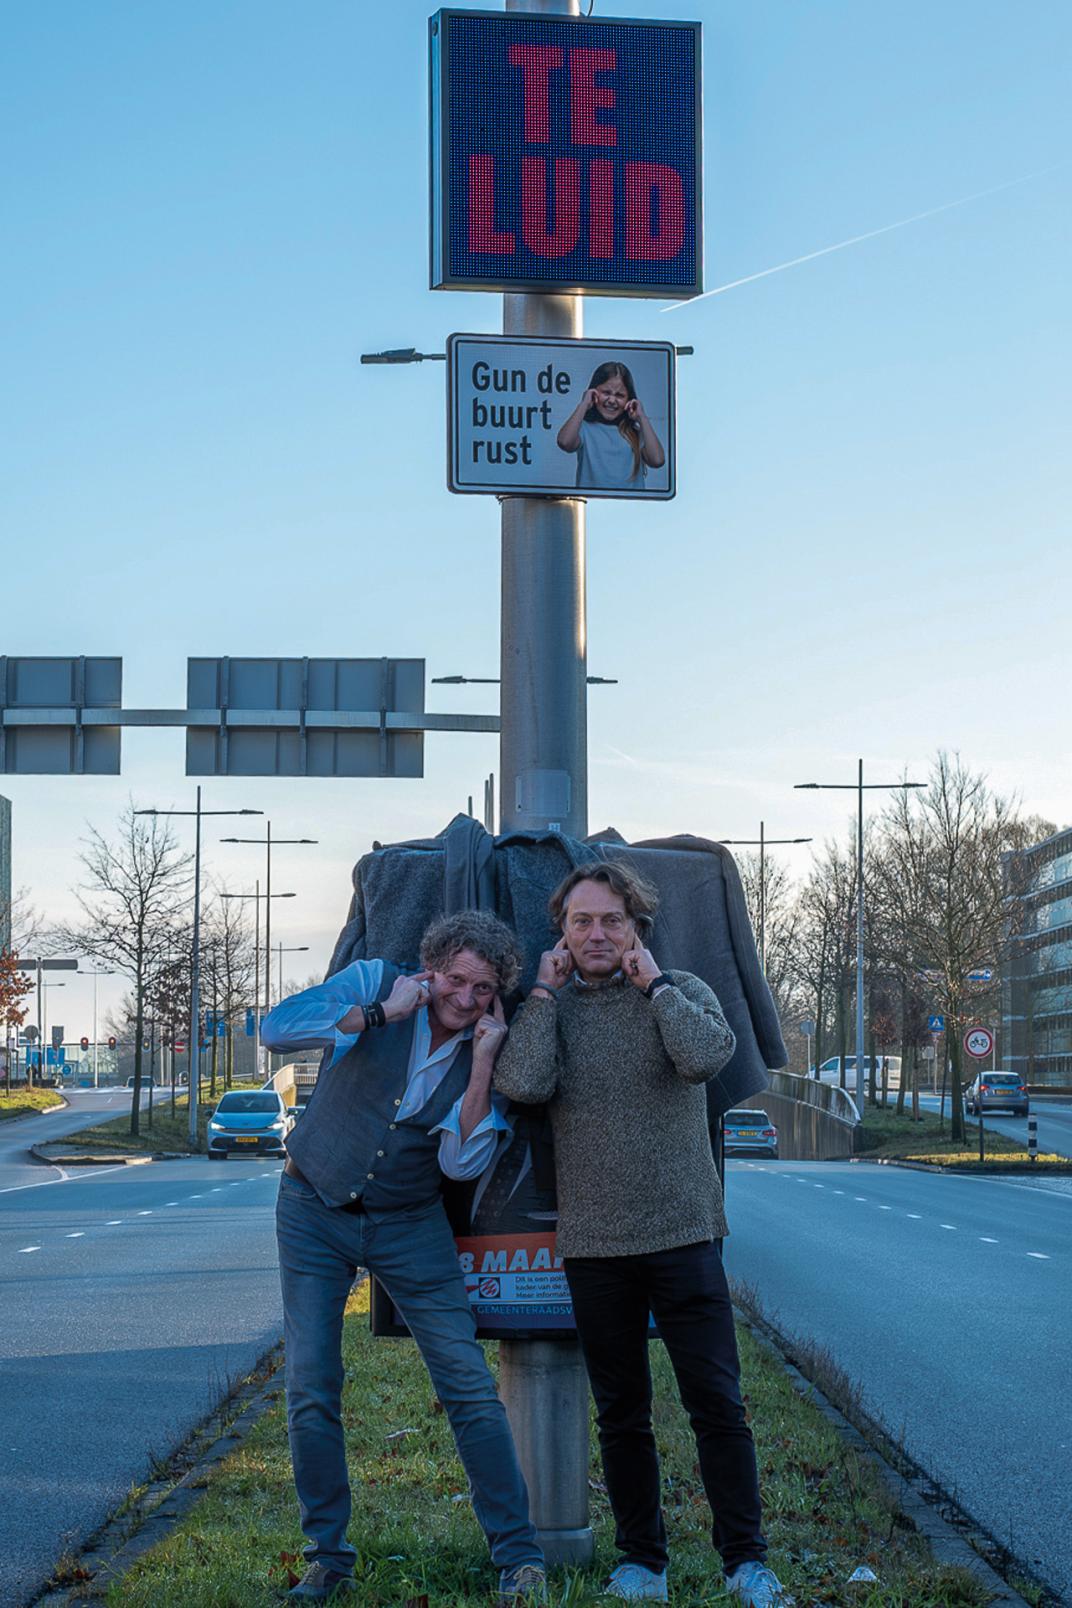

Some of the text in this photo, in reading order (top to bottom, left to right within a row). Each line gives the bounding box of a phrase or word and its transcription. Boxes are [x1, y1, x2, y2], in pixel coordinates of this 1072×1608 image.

[509, 44, 616, 146] TE
[469, 154, 685, 260] LUID
[472, 361, 571, 394] Gun de
[472, 397, 552, 429] buurt
[472, 435, 532, 465] rust
